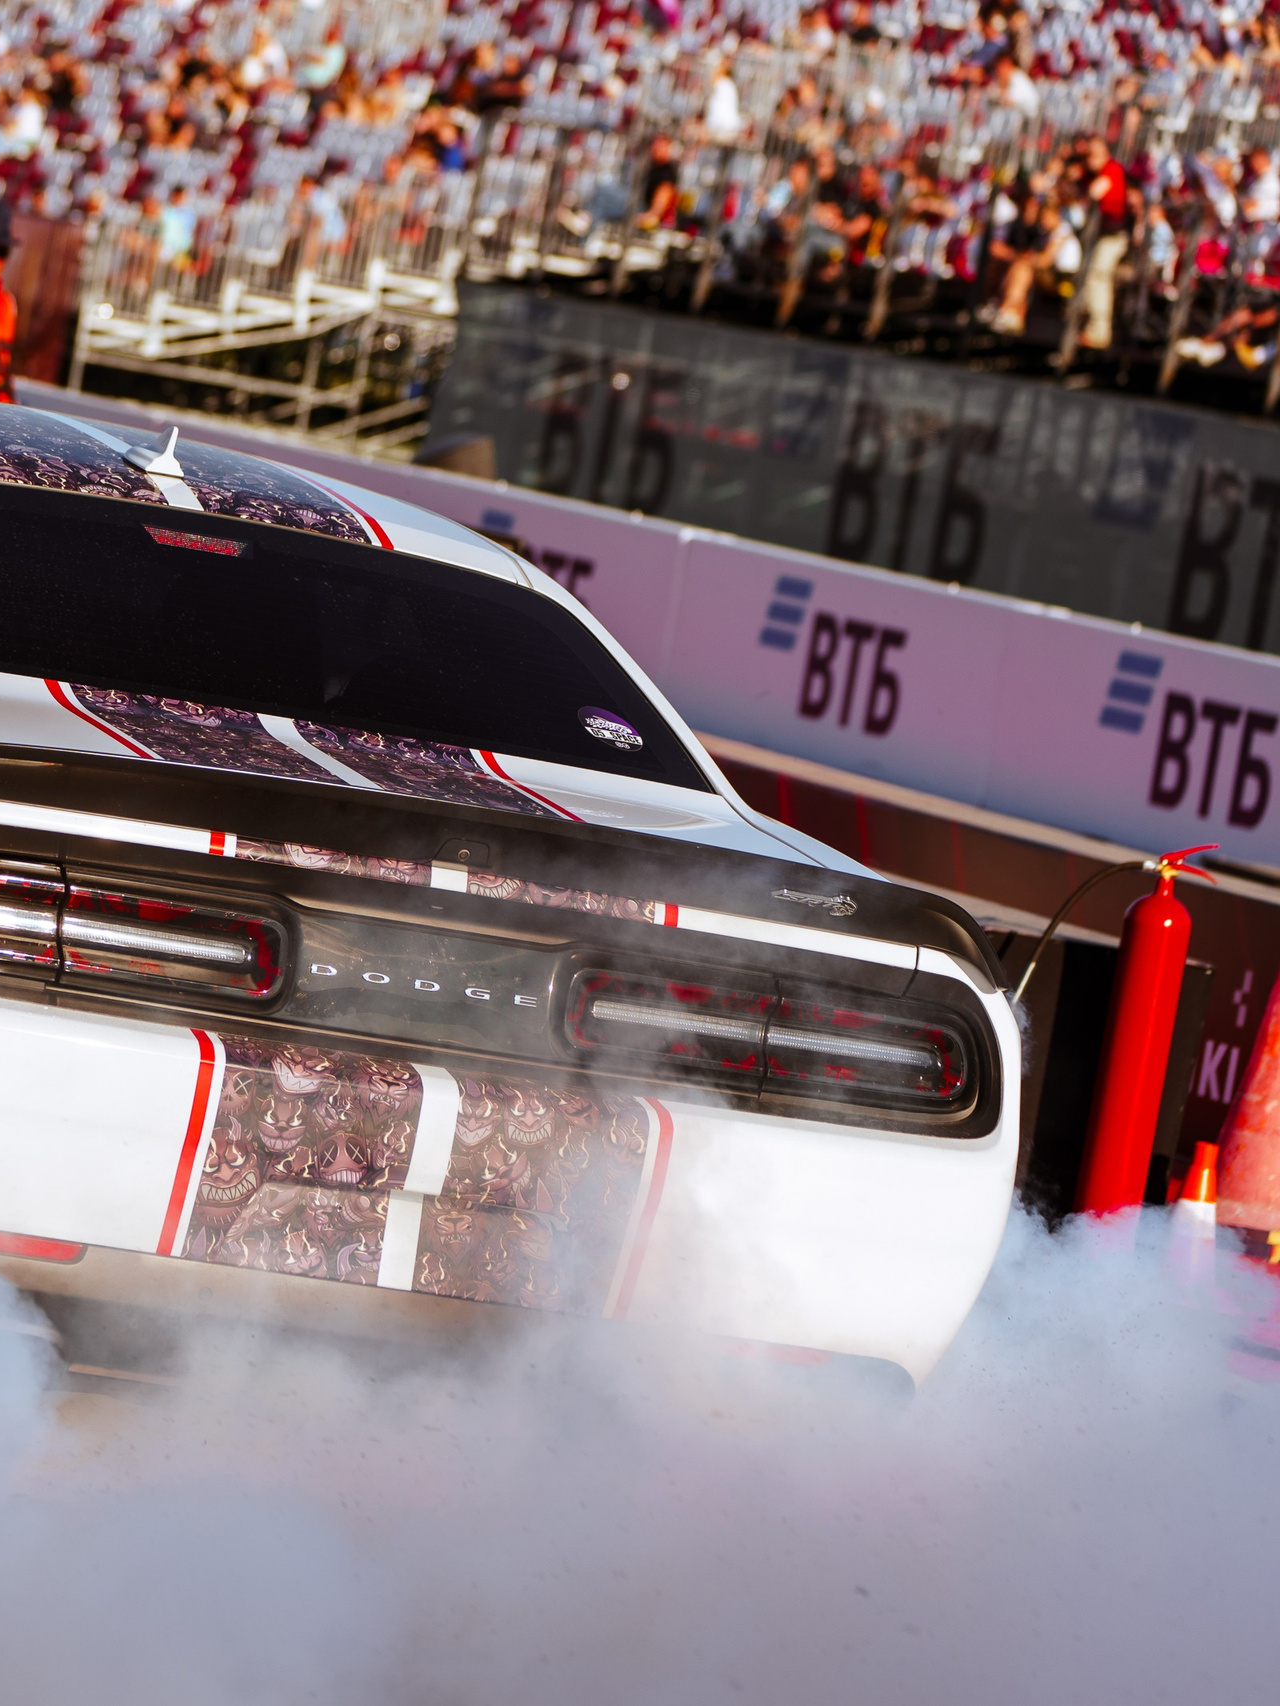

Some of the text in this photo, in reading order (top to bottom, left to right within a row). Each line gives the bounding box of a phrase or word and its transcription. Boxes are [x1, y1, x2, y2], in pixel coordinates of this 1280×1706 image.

[798, 609, 909, 739] ВТБ
[608, 731, 642, 745] SPACE
[1148, 688, 1279, 831] ВТБ
[310, 963, 538, 1009] DODGE
[1187, 1039, 1241, 1105] KI
